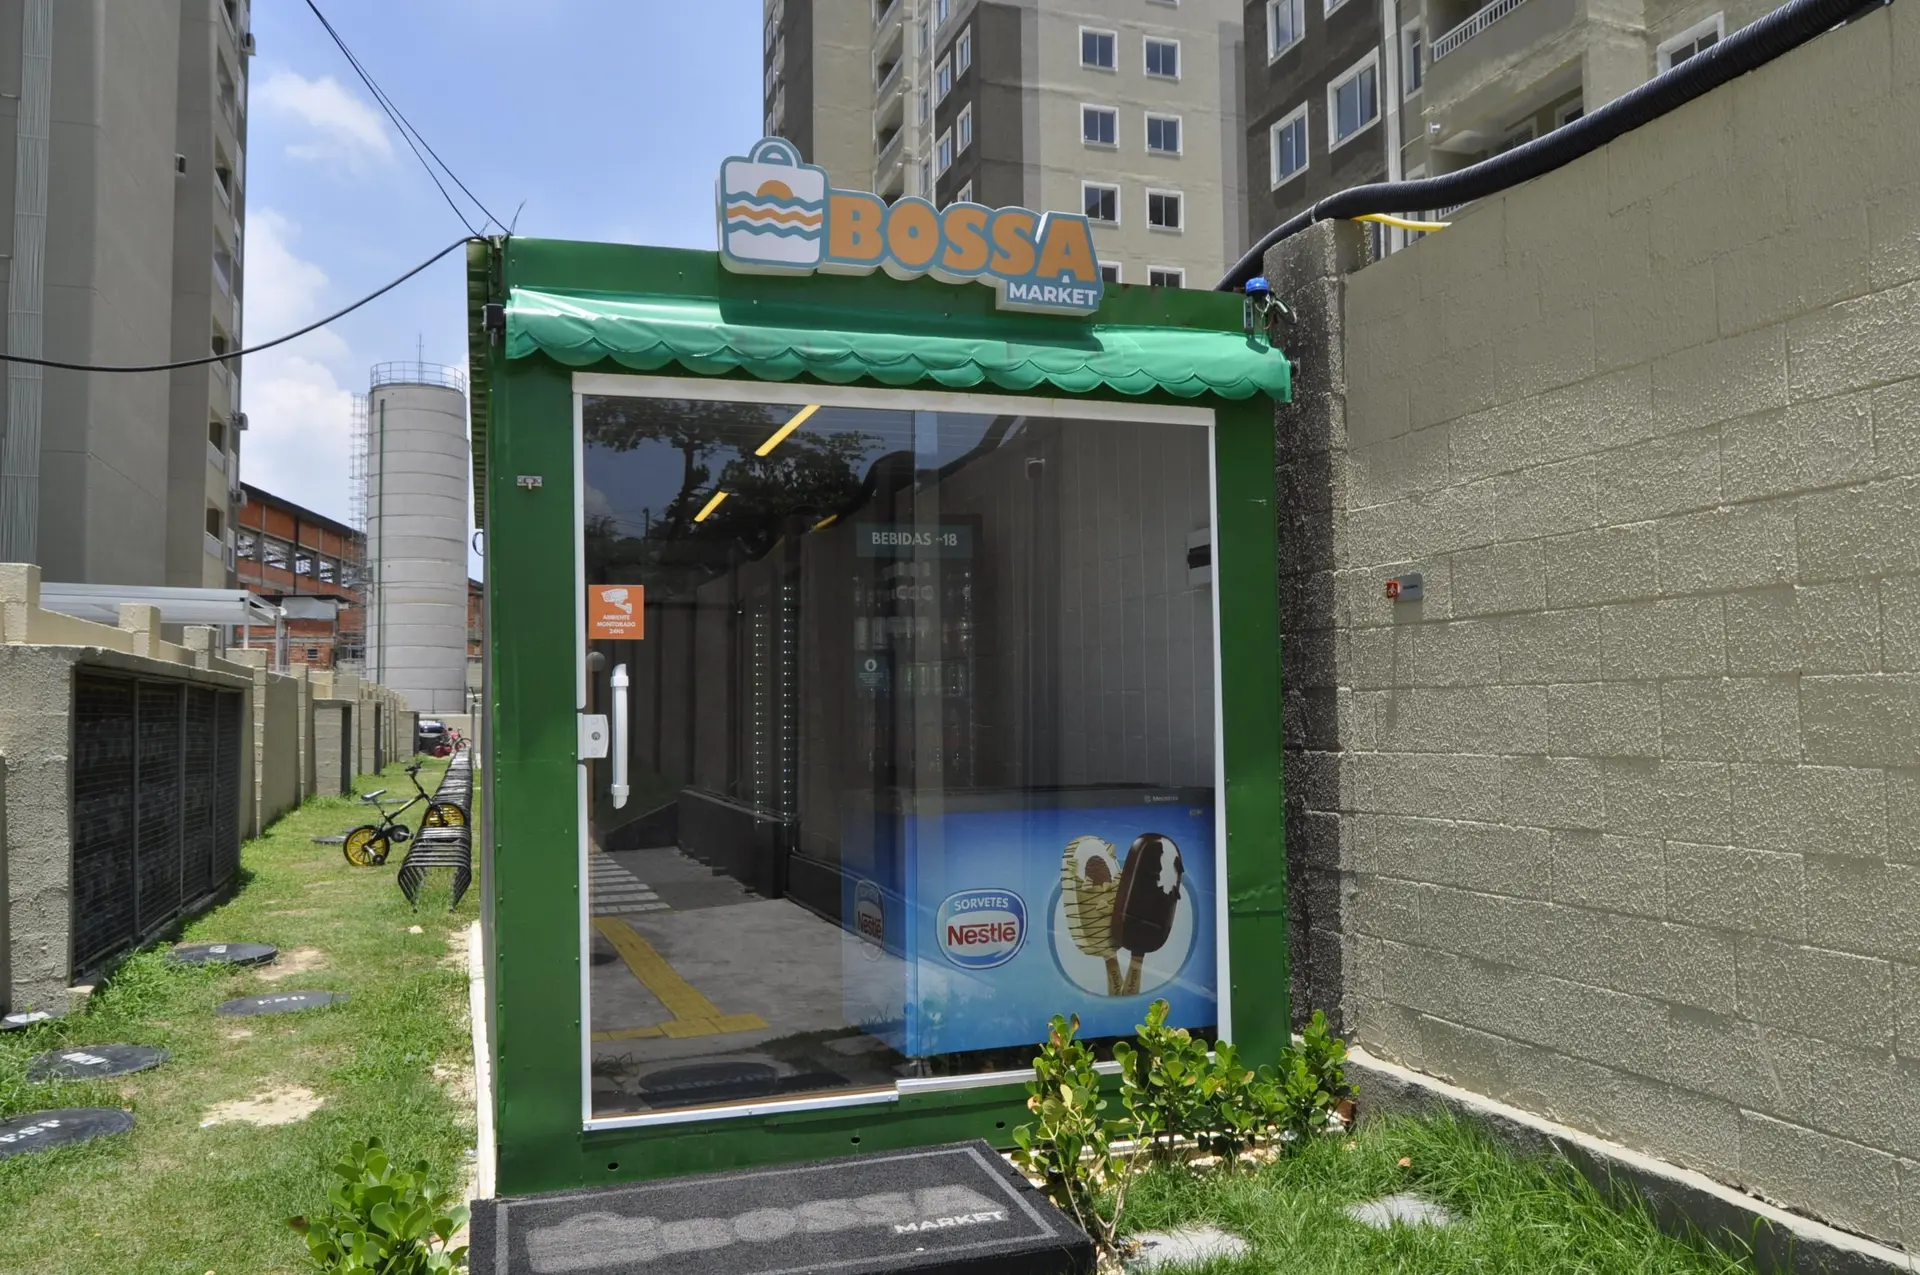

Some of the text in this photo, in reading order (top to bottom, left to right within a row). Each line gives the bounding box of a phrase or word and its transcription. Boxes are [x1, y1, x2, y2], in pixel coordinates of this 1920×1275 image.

[829, 195, 1097, 283] BOSSA
[1009, 282, 1098, 306] MARKET
[872, 532, 932, 546] BEBIDAS
[954, 897, 1009, 912] SORVETES
[947, 921, 1017, 946] Nestlé
[894, 1210, 1004, 1234] MARKET
